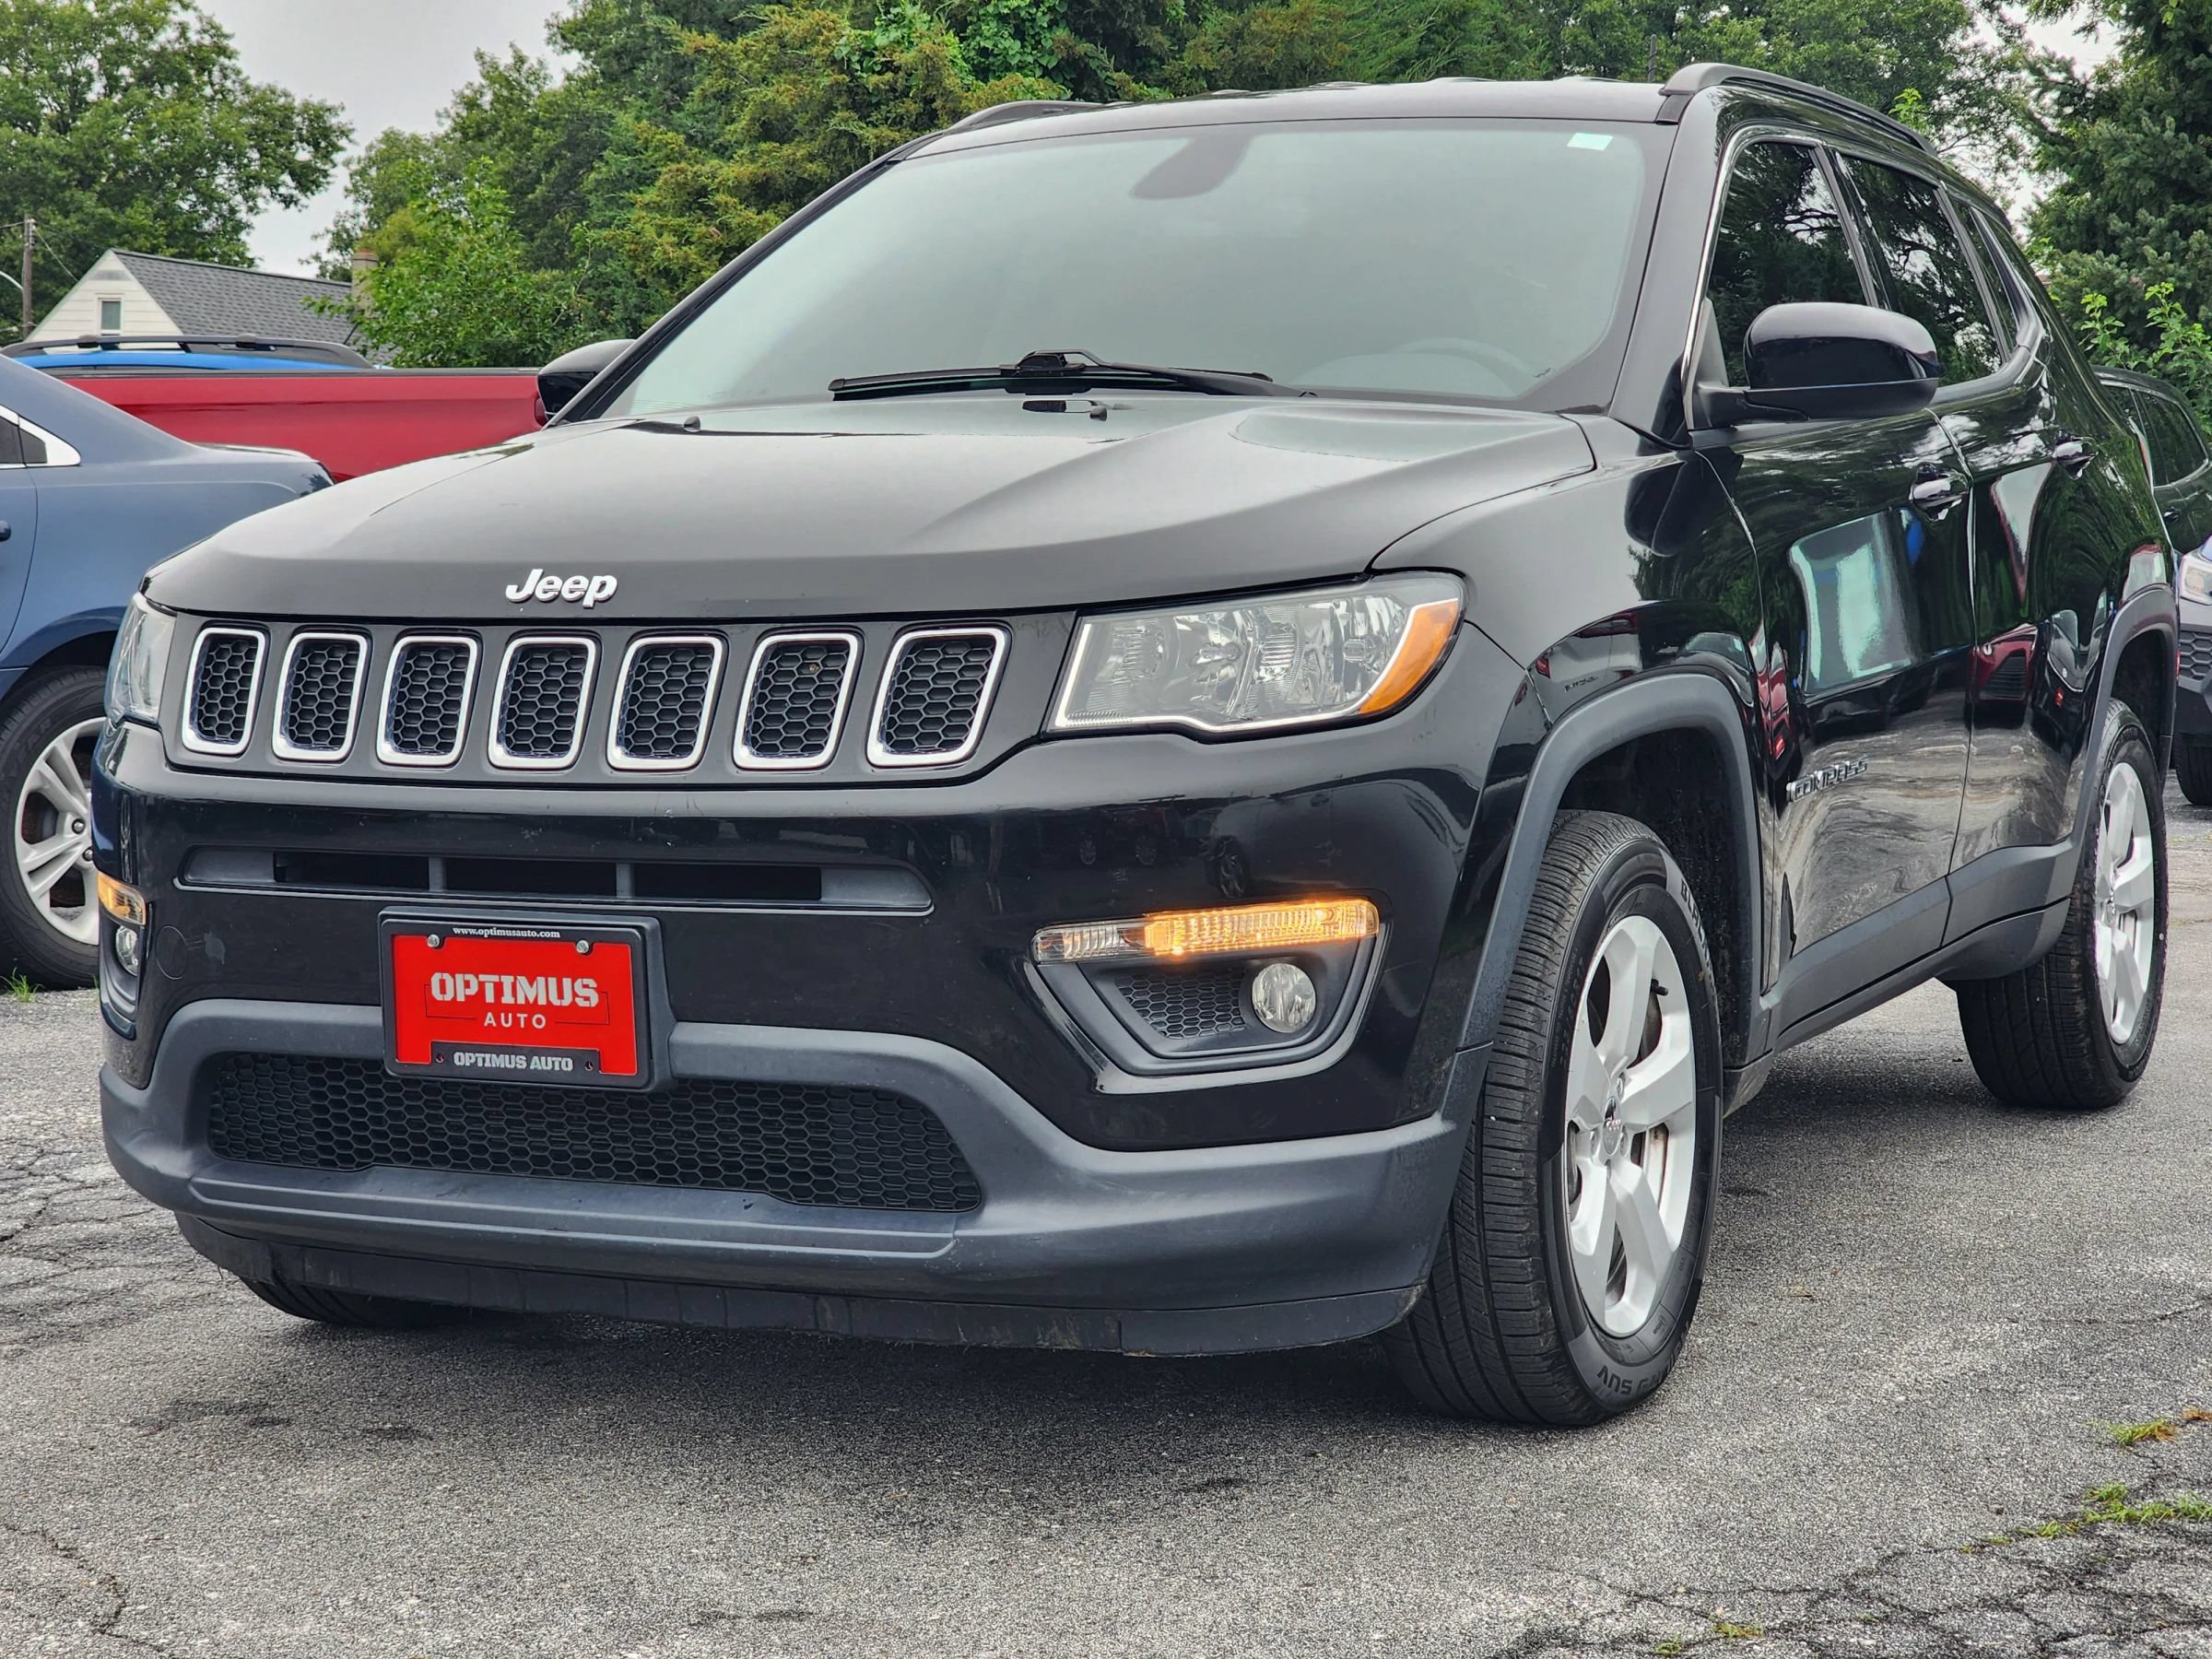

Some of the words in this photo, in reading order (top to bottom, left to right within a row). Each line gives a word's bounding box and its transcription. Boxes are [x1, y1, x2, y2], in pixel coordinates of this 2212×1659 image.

[505, 569, 618, 608] Jeep
[453, 927, 560, 938] www.optimusauto.com
[430, 972, 599, 1007] OPTIMUS
[484, 1012, 547, 1030] AUTO
[453, 1052, 527, 1070] OPTIMUS
[530, 1055, 573, 1071] AUTO
[1596, 1365, 1632, 1394] SUV
